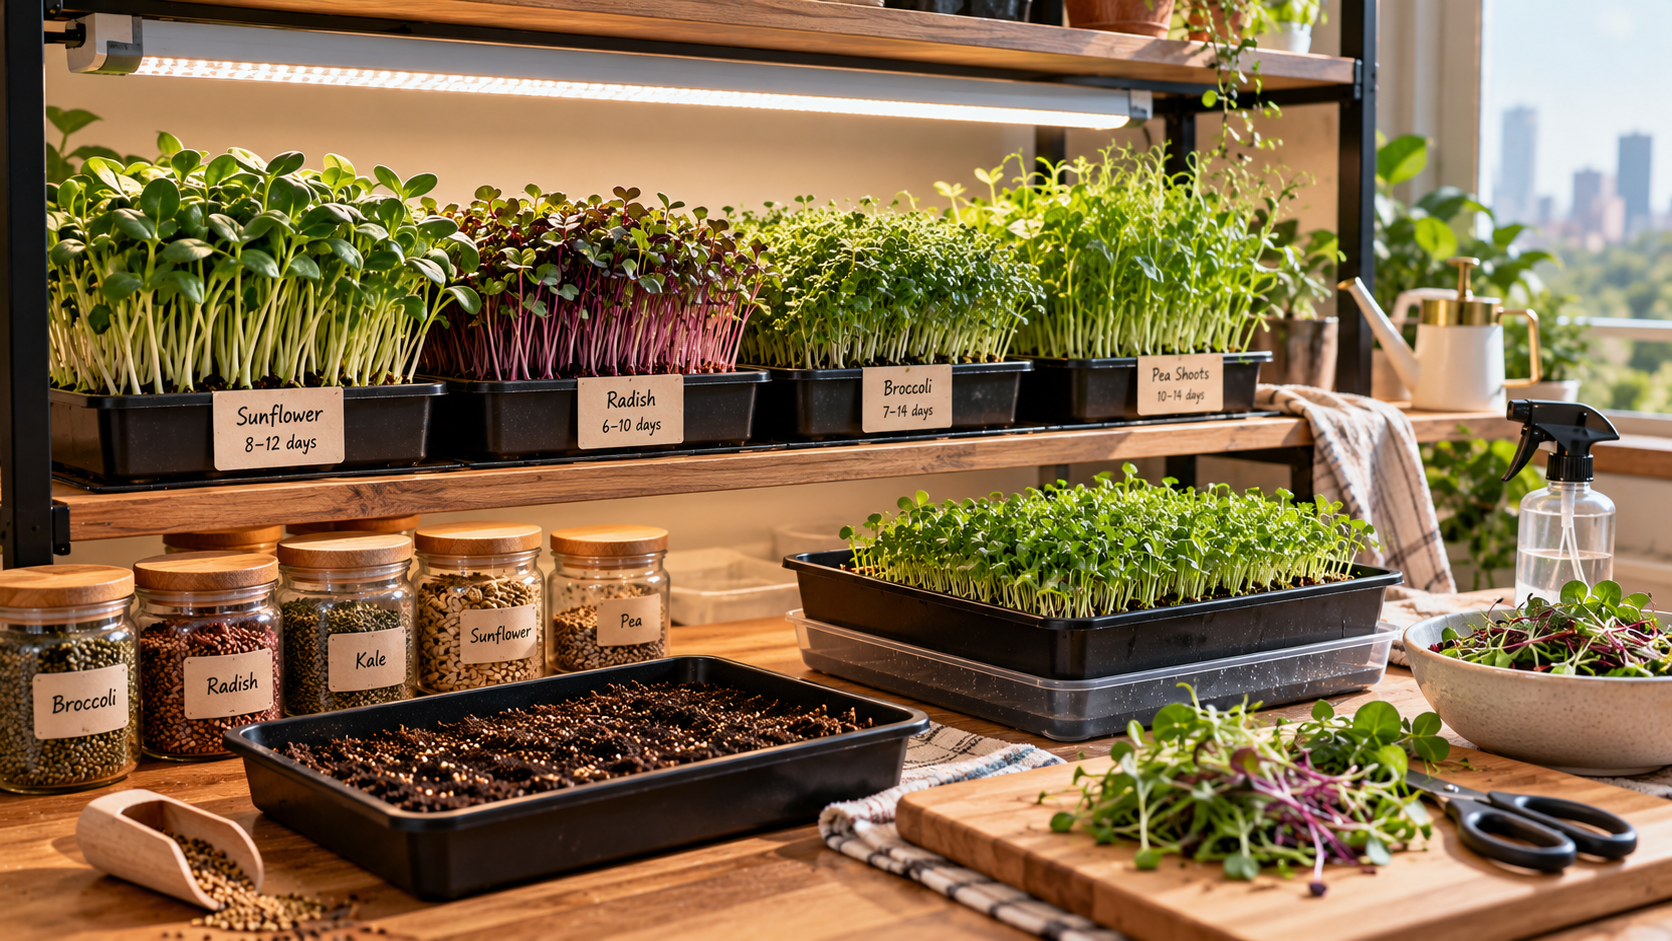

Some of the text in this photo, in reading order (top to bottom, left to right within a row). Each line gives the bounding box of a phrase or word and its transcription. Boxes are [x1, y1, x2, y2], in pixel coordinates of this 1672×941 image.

[1152, 366, 1210, 382] Pea Shoots
[884, 377, 932, 396] Broccoli
[1157, 388, 1205, 405] 10–14 days
[607, 389, 656, 409] Radish
[236, 404, 324, 427] Sunflower
[883, 403, 934, 421] 7–14 days
[602, 416, 662, 436] 6–10 days
[245, 433, 317, 455] 8–12 days
[620, 613, 643, 629] Pea
[470, 625, 532, 645] Sunflower
[355, 649, 387, 670] Kale
[206, 671, 259, 696] Radish
[52, 687, 116, 715] Broccoli
